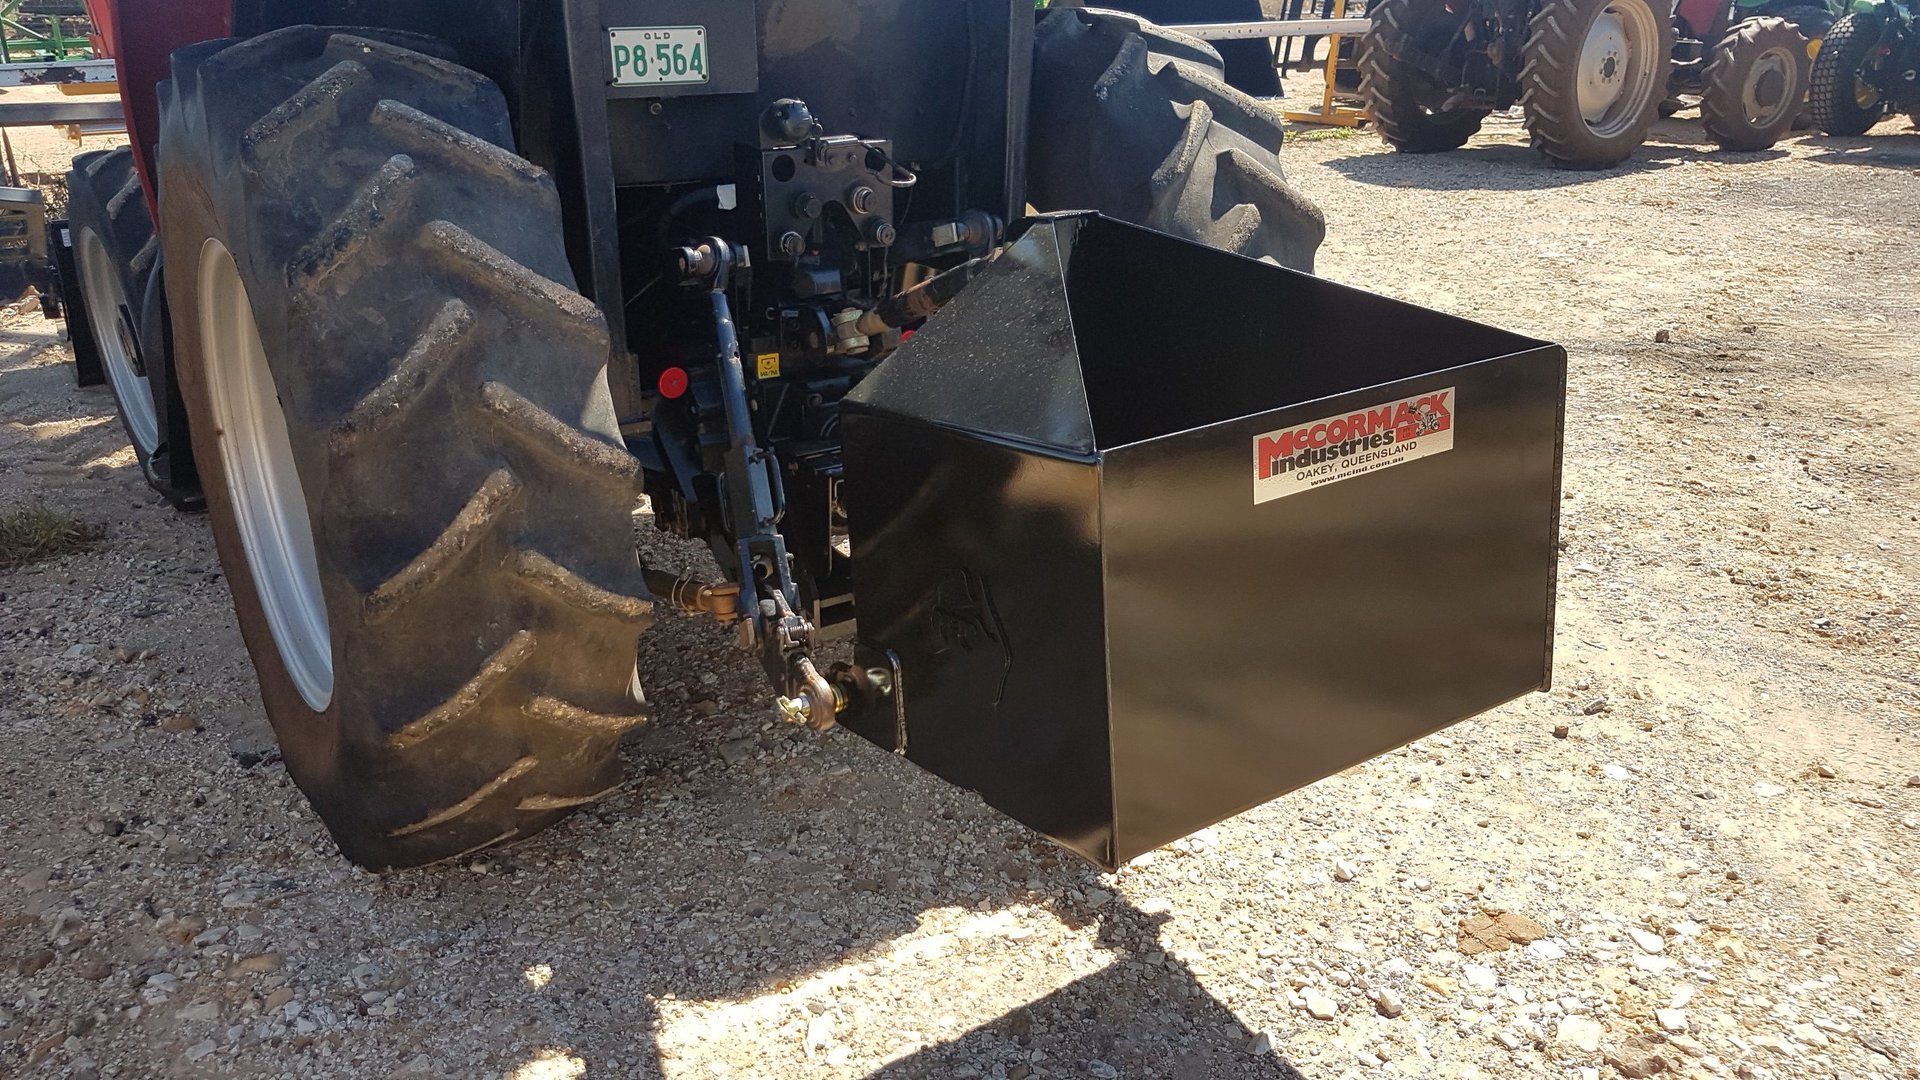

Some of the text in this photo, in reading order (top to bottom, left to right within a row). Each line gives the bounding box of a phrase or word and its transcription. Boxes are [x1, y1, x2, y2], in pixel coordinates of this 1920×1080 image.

[644, 32, 671, 40] QLD
[1296, 441, 1417, 482] OAKEY, QUEENSLAND
[1310, 456, 1405, 487] www.mcind.com.au
